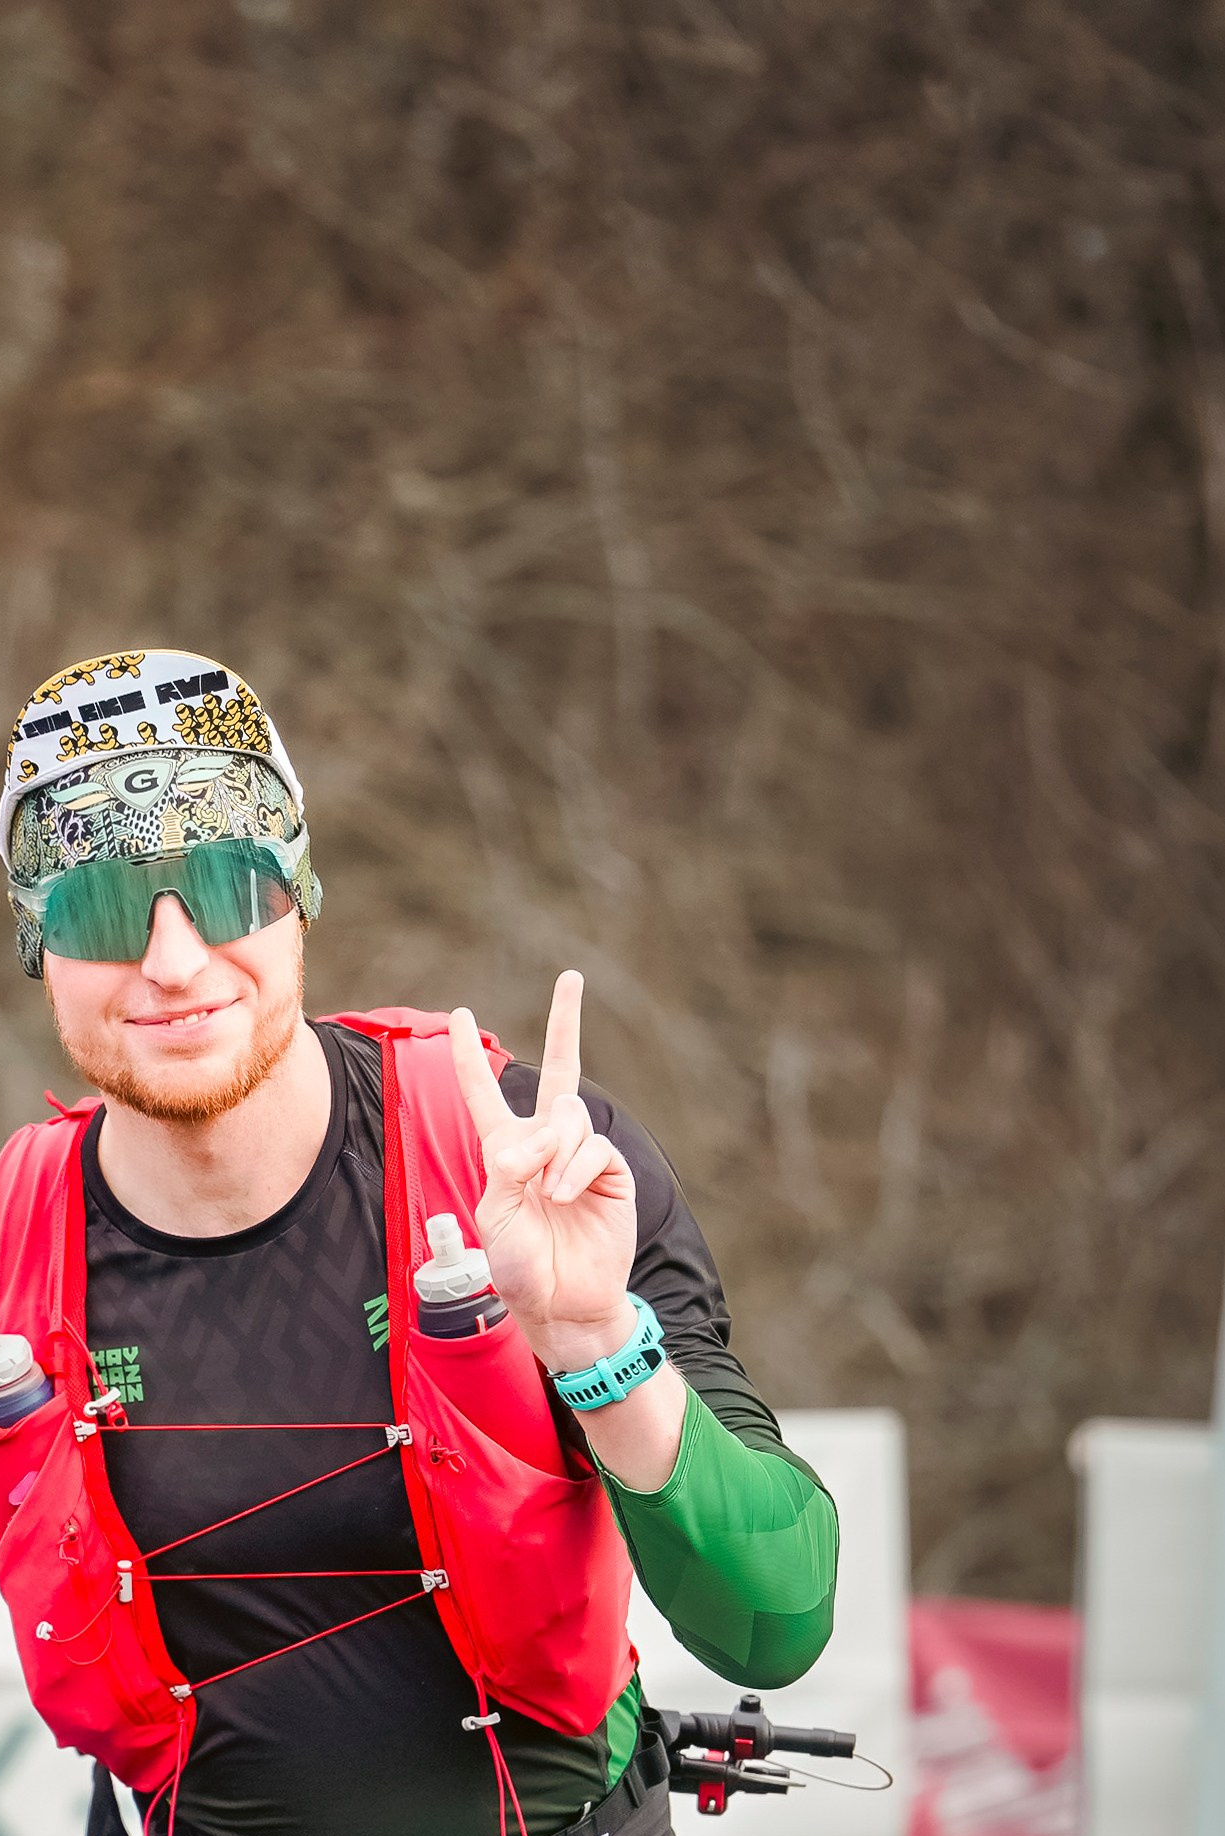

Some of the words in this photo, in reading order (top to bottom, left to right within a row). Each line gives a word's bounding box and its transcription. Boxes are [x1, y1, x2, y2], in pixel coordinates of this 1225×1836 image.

[78, 690, 146, 723] BIKE
[155, 670, 230, 705] RUN
[124, 769, 159, 794] G
